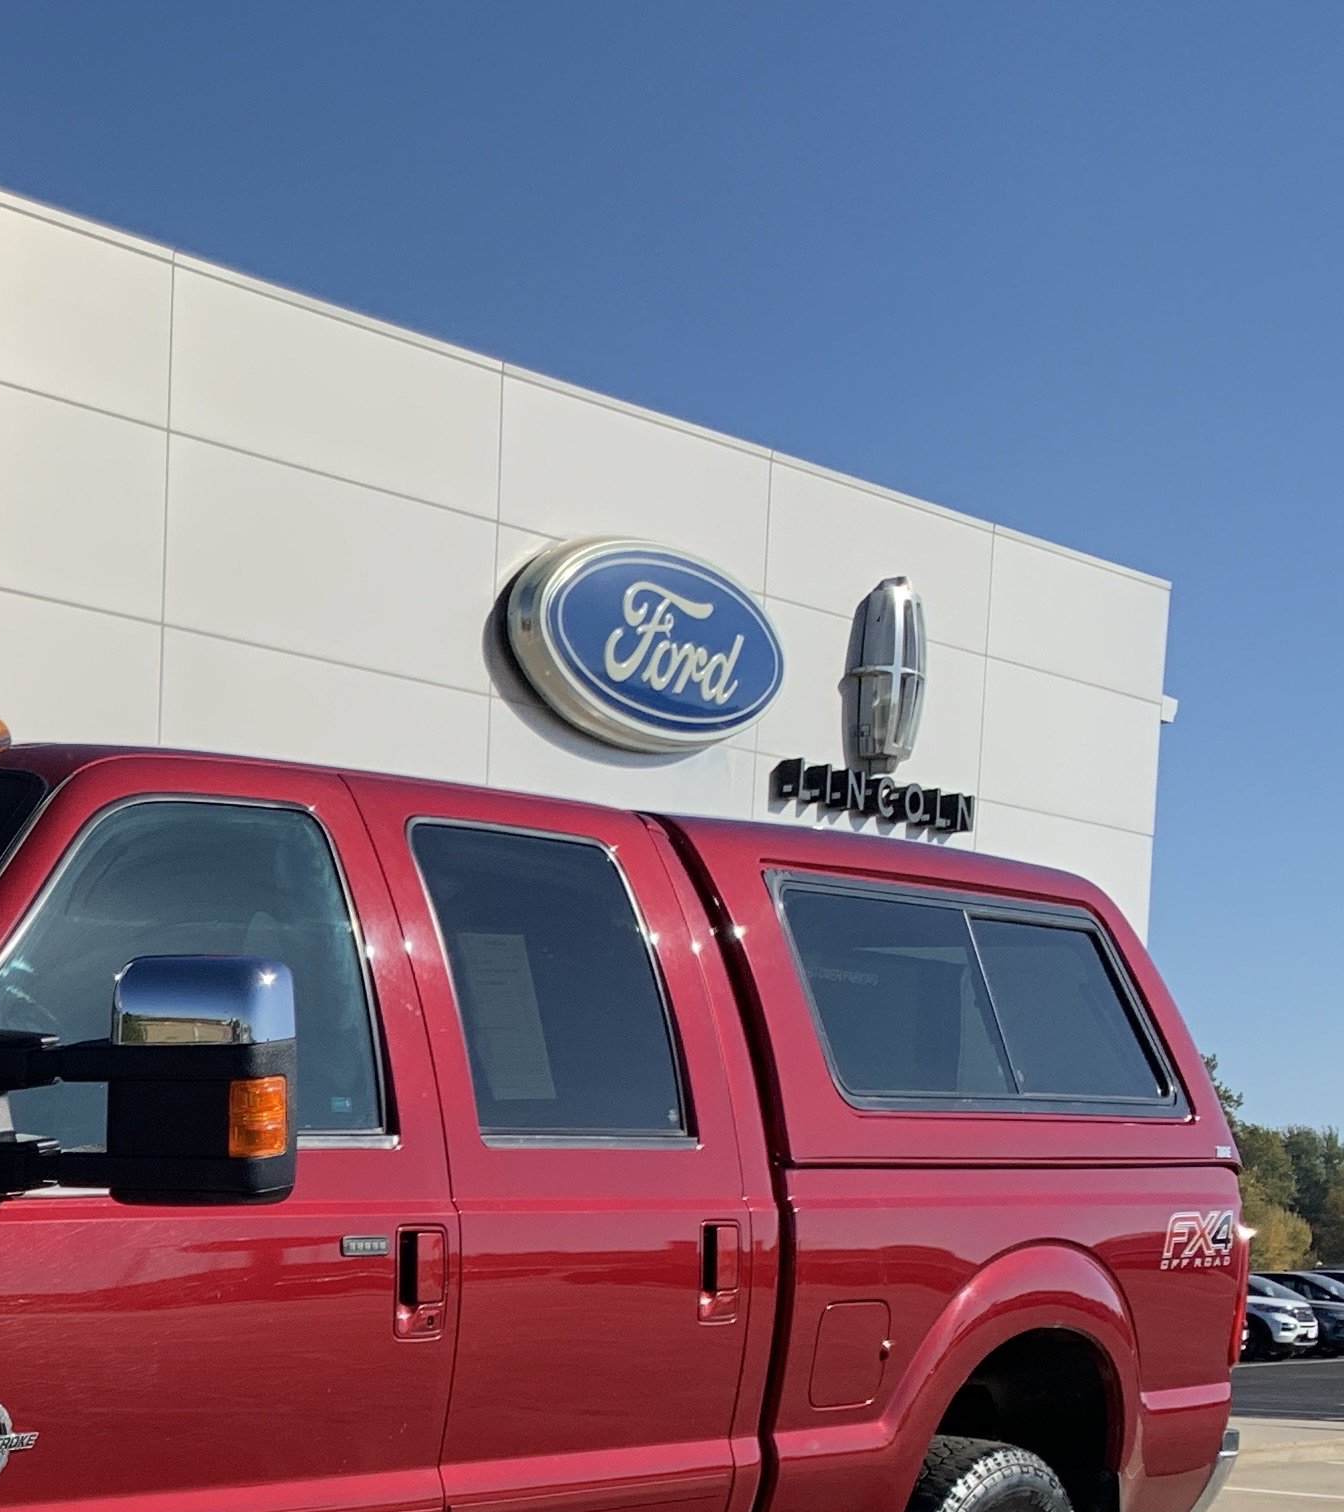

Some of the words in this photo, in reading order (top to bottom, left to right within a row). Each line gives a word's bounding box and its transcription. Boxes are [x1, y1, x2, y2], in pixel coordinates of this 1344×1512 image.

[604, 580, 745, 705] Ford
[782, 757, 976, 832] LINCOLN
[1160, 1258, 1190, 1270] OFF
[1193, 1256, 1231, 1268] ROAD
[1162, 1210, 1234, 1259] FX4
